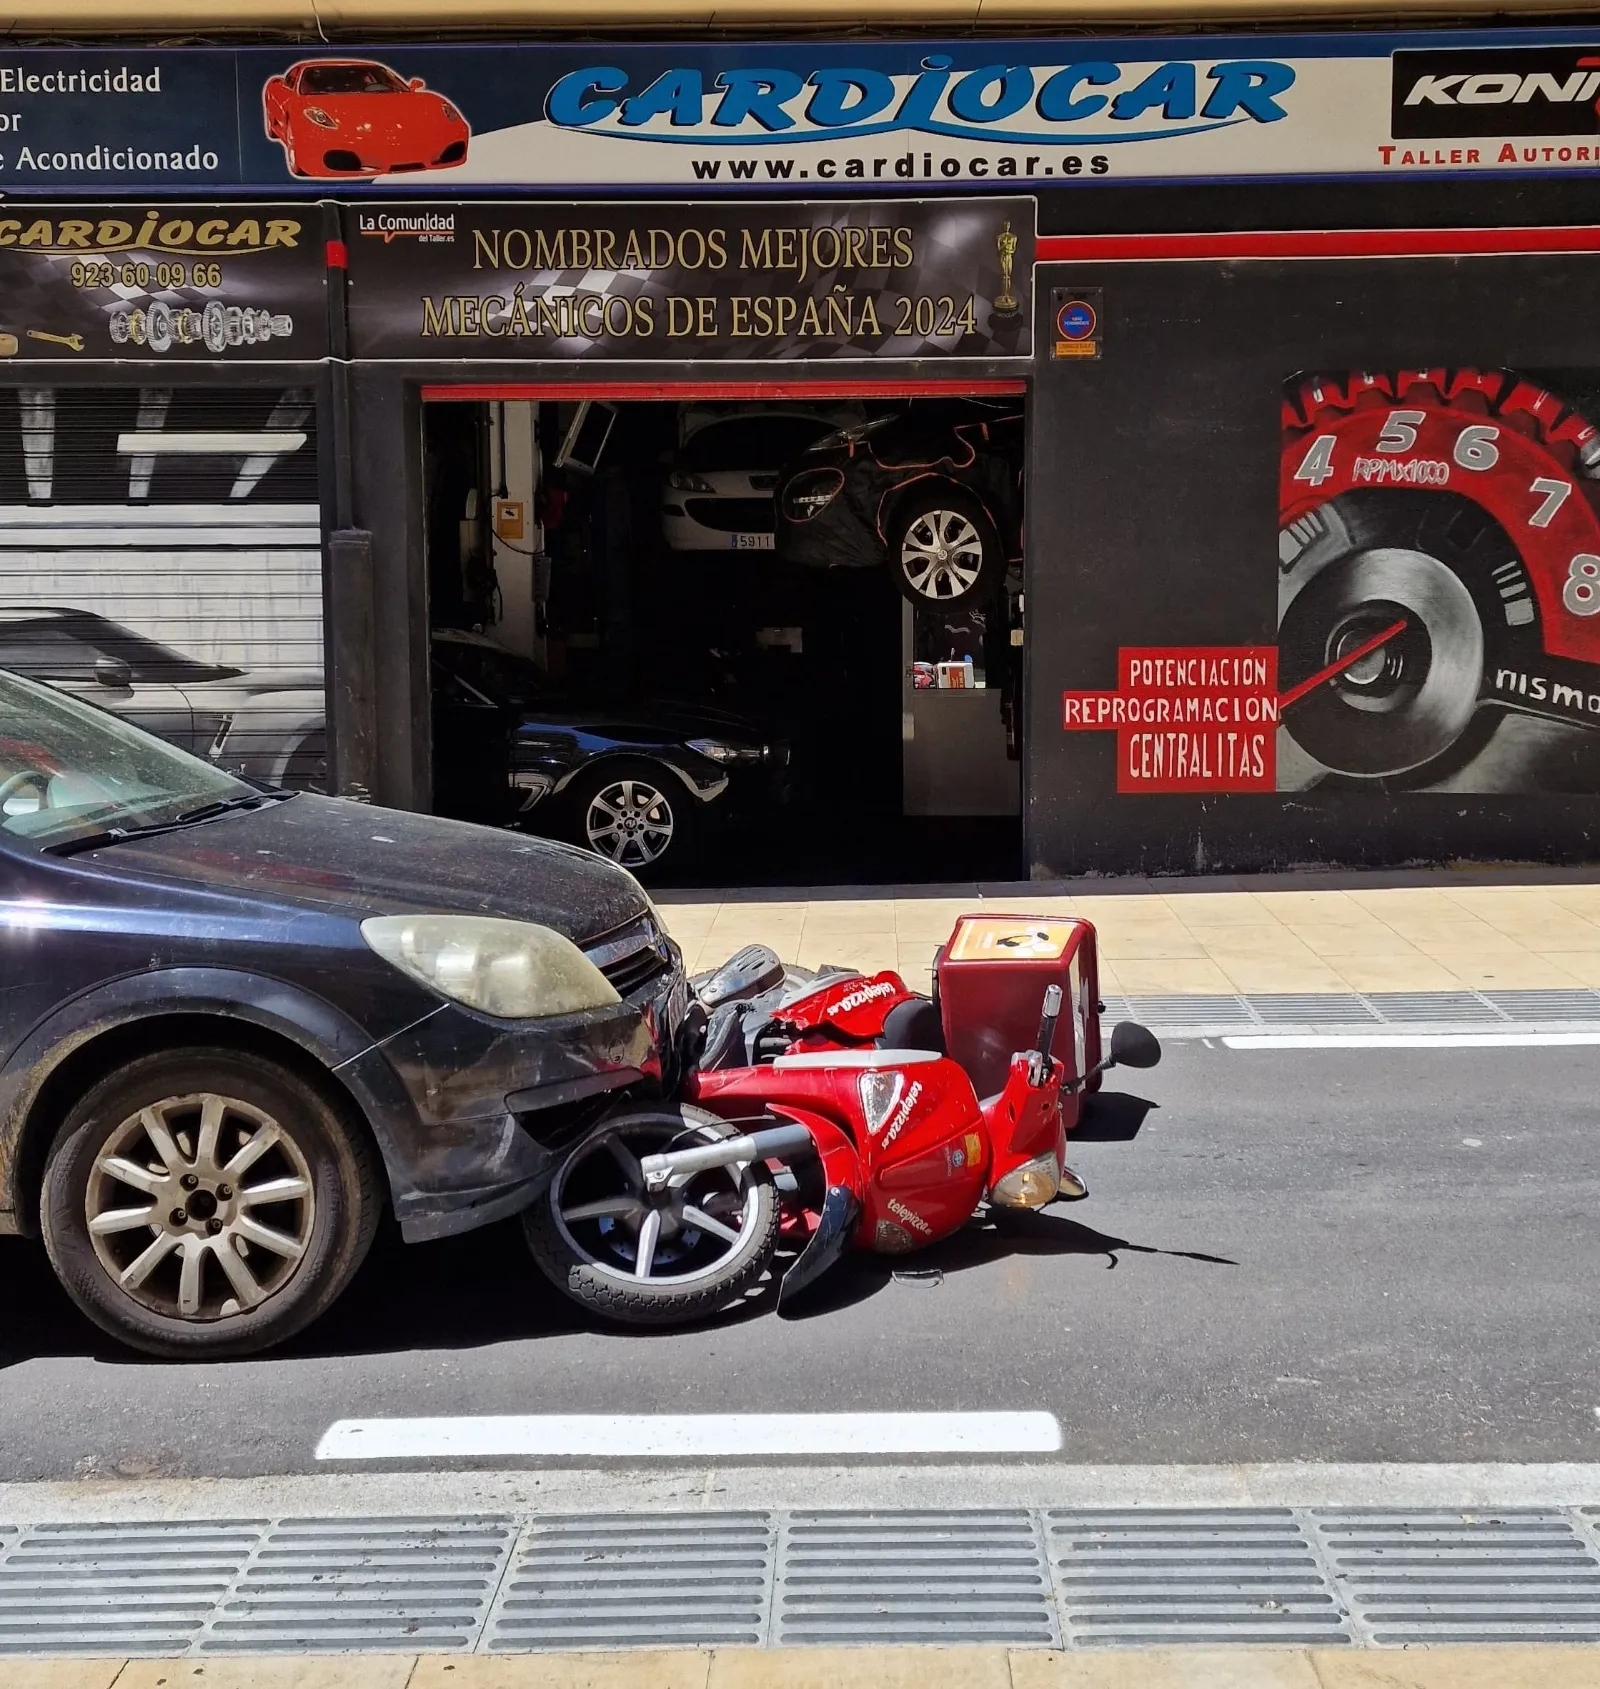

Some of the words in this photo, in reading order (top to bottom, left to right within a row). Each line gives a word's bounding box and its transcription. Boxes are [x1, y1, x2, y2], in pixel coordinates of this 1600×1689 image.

[1, 66, 162, 93] Electricidad
[1403, 71, 1600, 106] KONI
[15, 144, 219, 170] Acondicionado
[691, 151, 1110, 180] www.cardiocar.es
[1378, 145, 1480, 165] TALLER
[360, 214, 375, 230] La
[378, 212, 454, 231] Comunidad
[71, 262, 114, 287] 923
[120, 262, 150, 287] 60
[156, 262, 185, 287] 09
[191, 262, 222, 287] 66
[472, 228, 728, 270] NOMBRADOS
[739, 227, 915, 283] MEJORES
[421, 282, 655, 337] MECÁNICOS
[666, 296, 719, 337] DE
[730, 284, 883, 337] ESPAÑA
[894, 294, 977, 336] 2024
[1376, 410, 1427, 453] 5
[1453, 425, 1500, 471] 6
[1294, 435, 1337, 486] 4
[1529, 477, 1572, 527] 7
[740, 535, 770, 548] 5911
[1563, 553, 1600, 616] 8
[1495, 668, 1600, 714] nismo
[1130, 732, 1265, 778] CENTRALITAS
[881, 1080, 923, 1150] telepizza.es
[887, 1197, 933, 1236] telepizza.es
